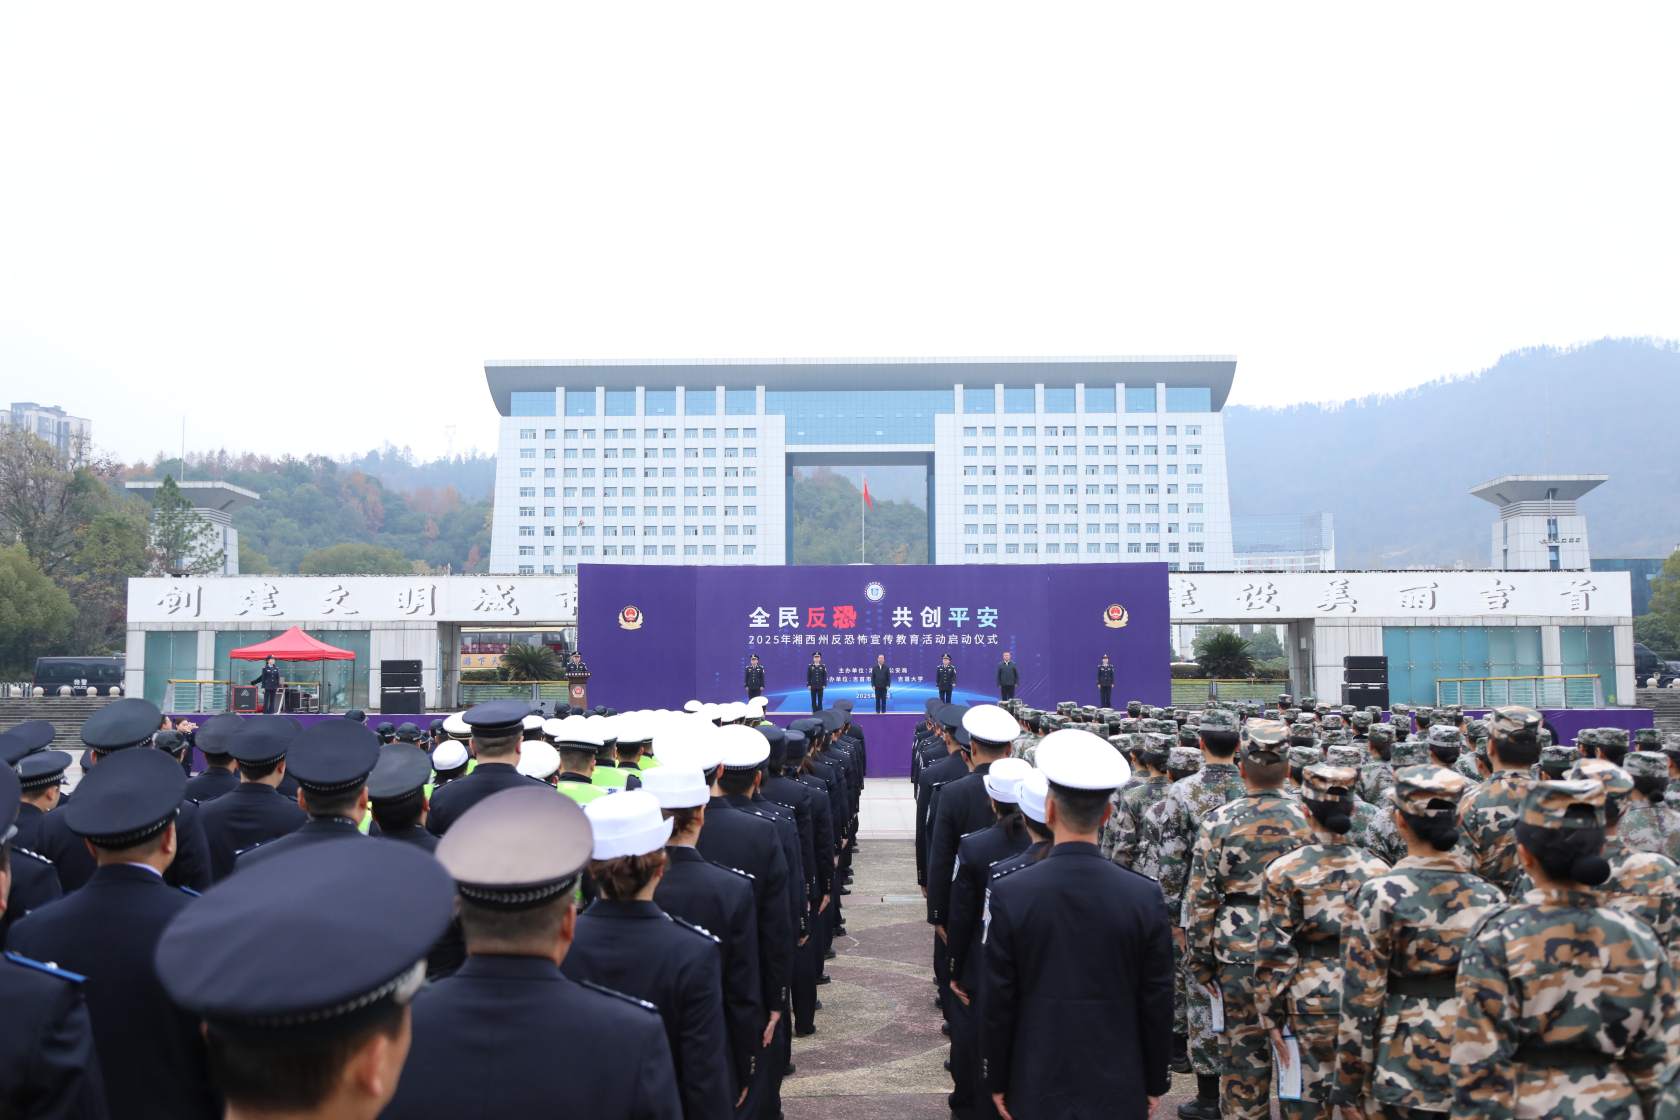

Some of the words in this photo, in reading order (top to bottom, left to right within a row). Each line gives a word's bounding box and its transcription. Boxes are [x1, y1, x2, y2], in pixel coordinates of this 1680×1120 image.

[749, 605, 857, 629] 全民反恐
[892, 606, 998, 628] 共创平安
[748, 634, 998, 645] 2025年湘西州反恐怖宣传教育活动启动仪式
